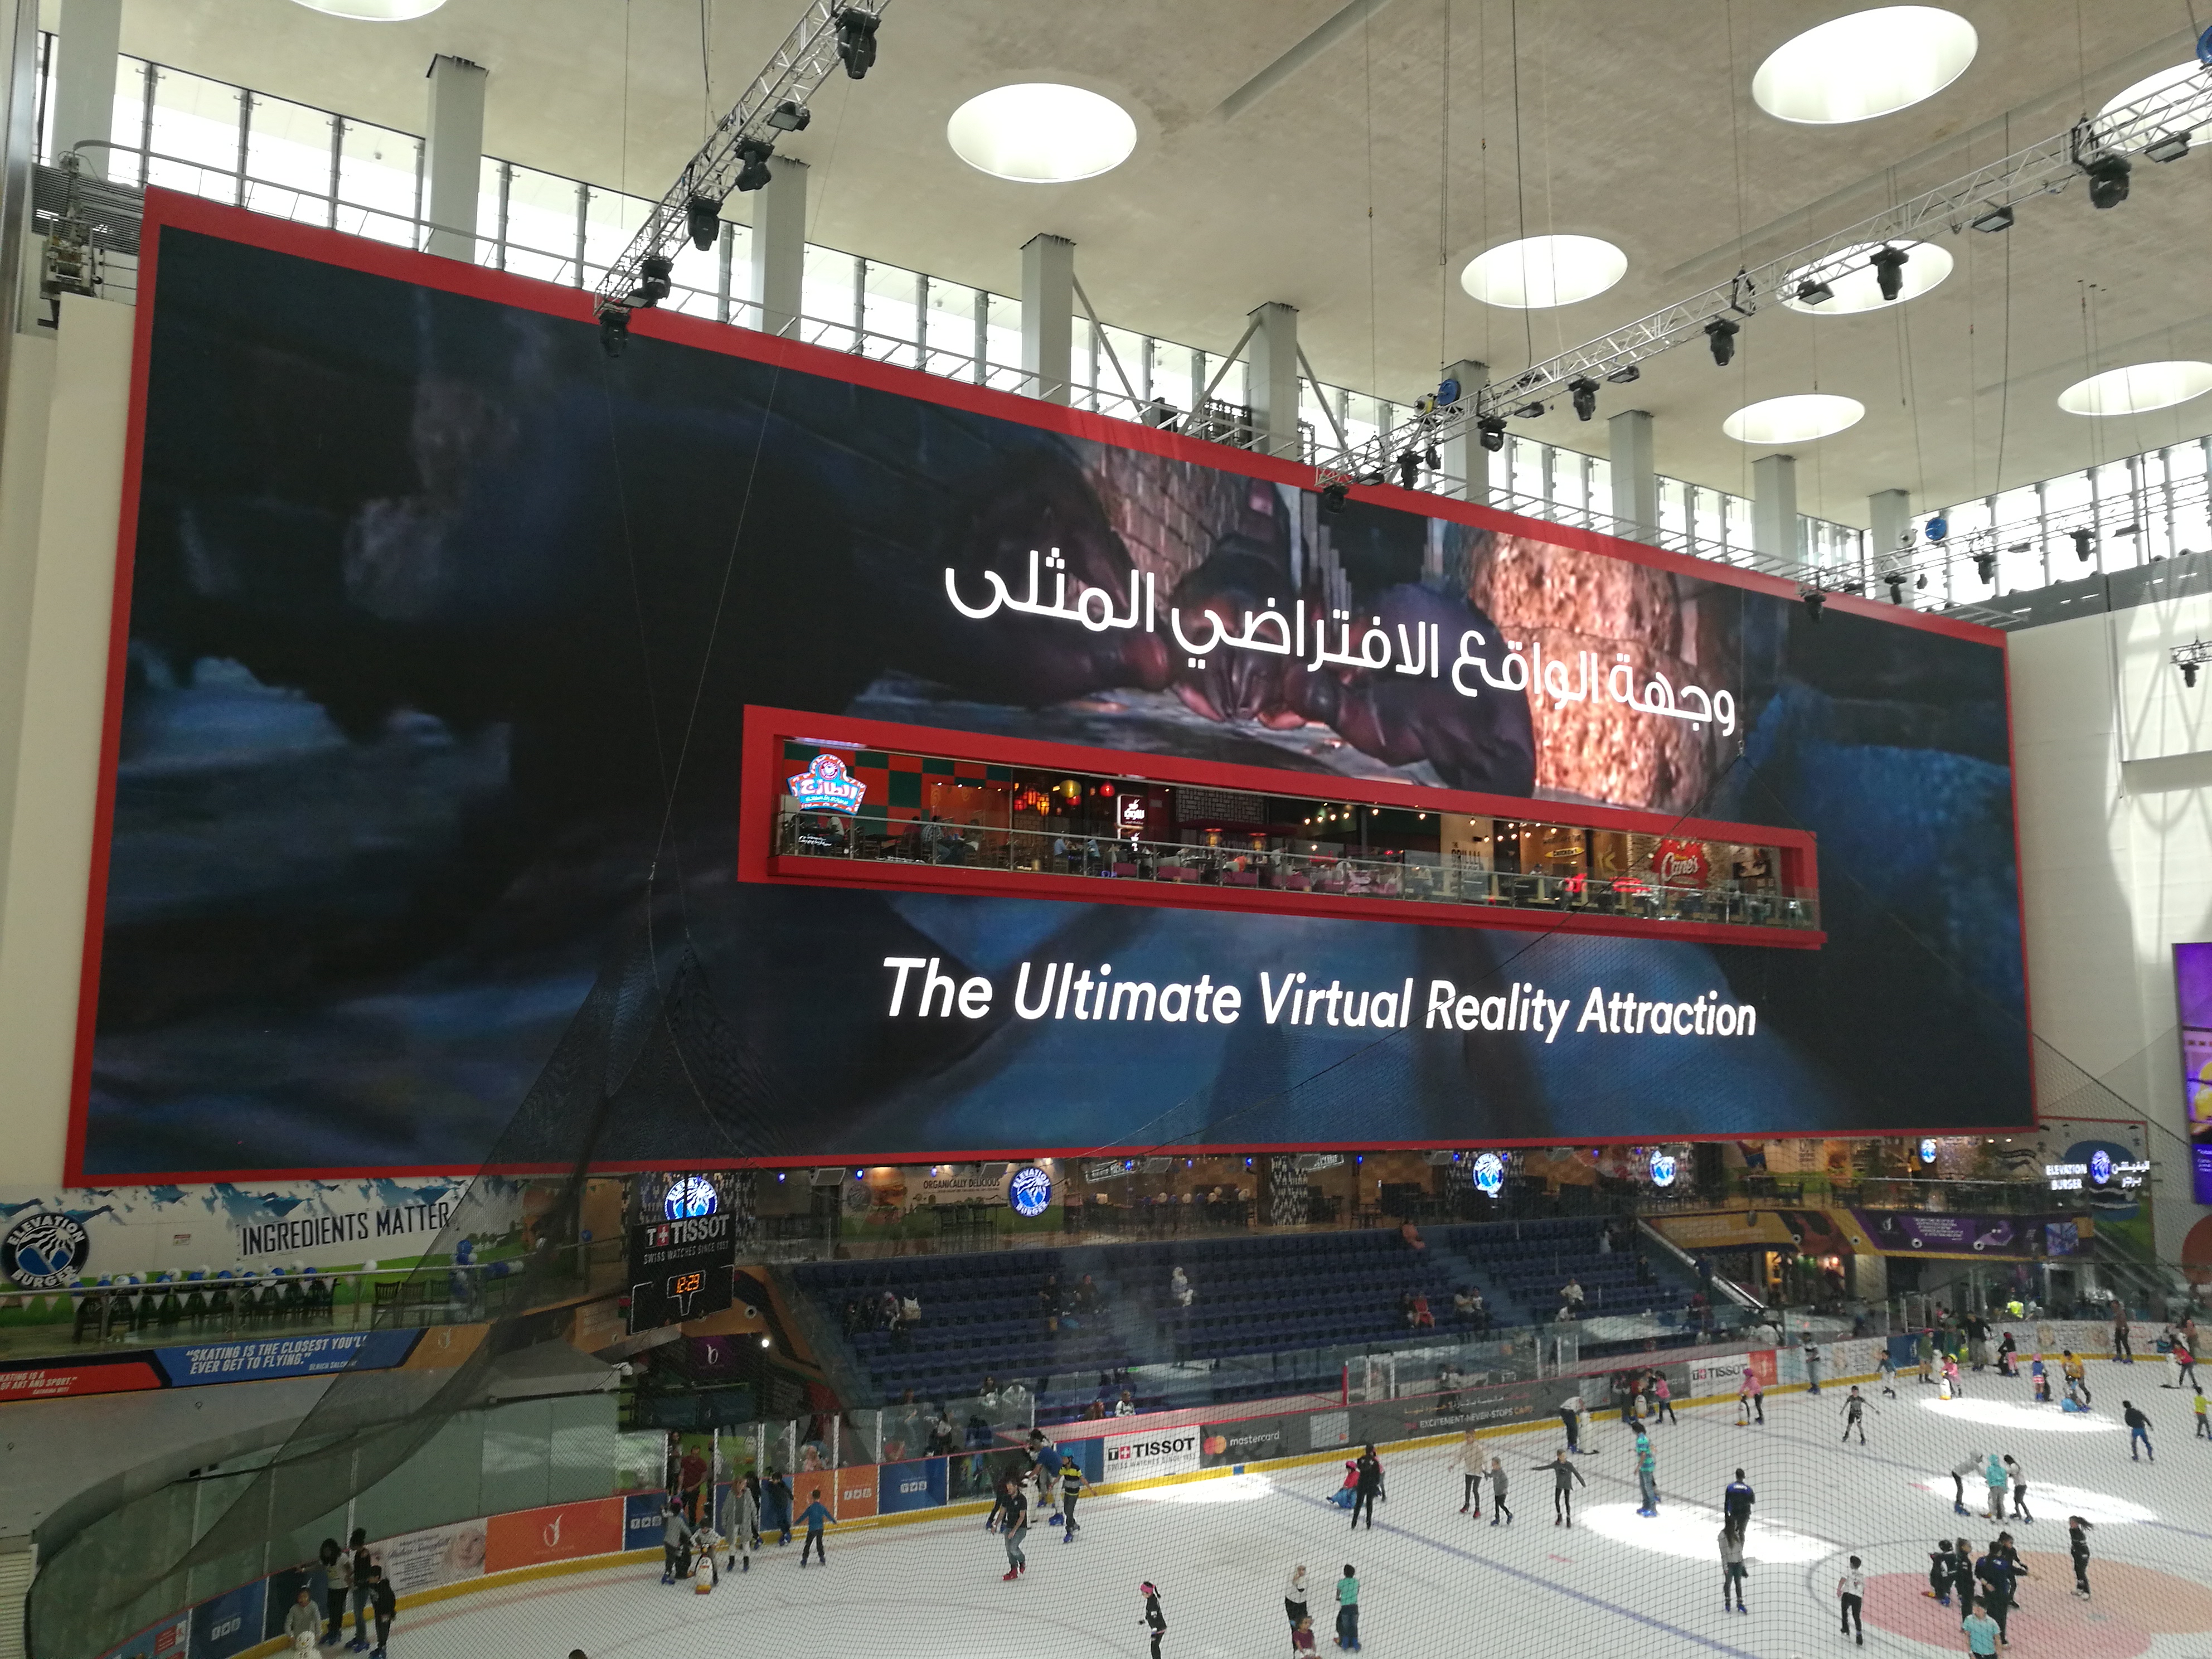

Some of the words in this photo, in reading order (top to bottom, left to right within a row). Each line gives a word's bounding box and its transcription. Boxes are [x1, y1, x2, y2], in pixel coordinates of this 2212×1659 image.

[945, 547, 1154, 633] المثلى
[1171, 597, 1439, 678] الافتراضي
[1452, 629, 1599, 711] الواقع
[1609, 653, 1736, 737] وجهة
[800, 778, 859, 799] الطازج
[1661, 851, 1700, 882] Cane's
[882, 956, 993, 1019] The
[1013, 962, 1242, 1024] Ultimate
[1259, 971, 1414, 1029] Virtual
[1425, 979, 1570, 1044] Reality
[1576, 986, 1757, 1036] Attraction
[1013, 1167, 1051, 1188] ELEVATION
[2046, 1163, 2088, 1176] ELEVATION
[923, 1178, 968, 1189] ORGANICALLY
[969, 1177, 1000, 1187] DELICIOUS
[2051, 1178, 2083, 1190] BURGER
[1016, 1200, 1048, 1216] BURGER
[6, 1215, 86, 1246] ELEVATION
[242, 1212, 369, 1256] INGREDIENTS
[377, 1201, 450, 1238] MATTER
[671, 1214, 730, 1244] TISSOT
[643, 1251, 666, 1265] SWISS
[667, 1245, 697, 1260] WATCHES
[697, 1241, 716, 1255] SINCE
[11, 1265, 77, 1288] BURGER
[676, 1273, 700, 1293] 12:29
[242, 1345, 255, 1357] IS
[258, 1342, 280, 1356] THE
[280, 1338, 329, 1354] CLOSEST
[38, 1371, 45, 1379] A
[190, 1360, 220, 1375] EVER
[221, 1358, 241, 1372] GET
[248, 1356, 261, 1370] TO
[11, 1380, 28, 1389] ART
[1133, 1437, 1195, 1458] TISSOT
[1230, 1430, 1280, 1447] mastercard
[1130, 1457, 1160, 1467] WATCHES
